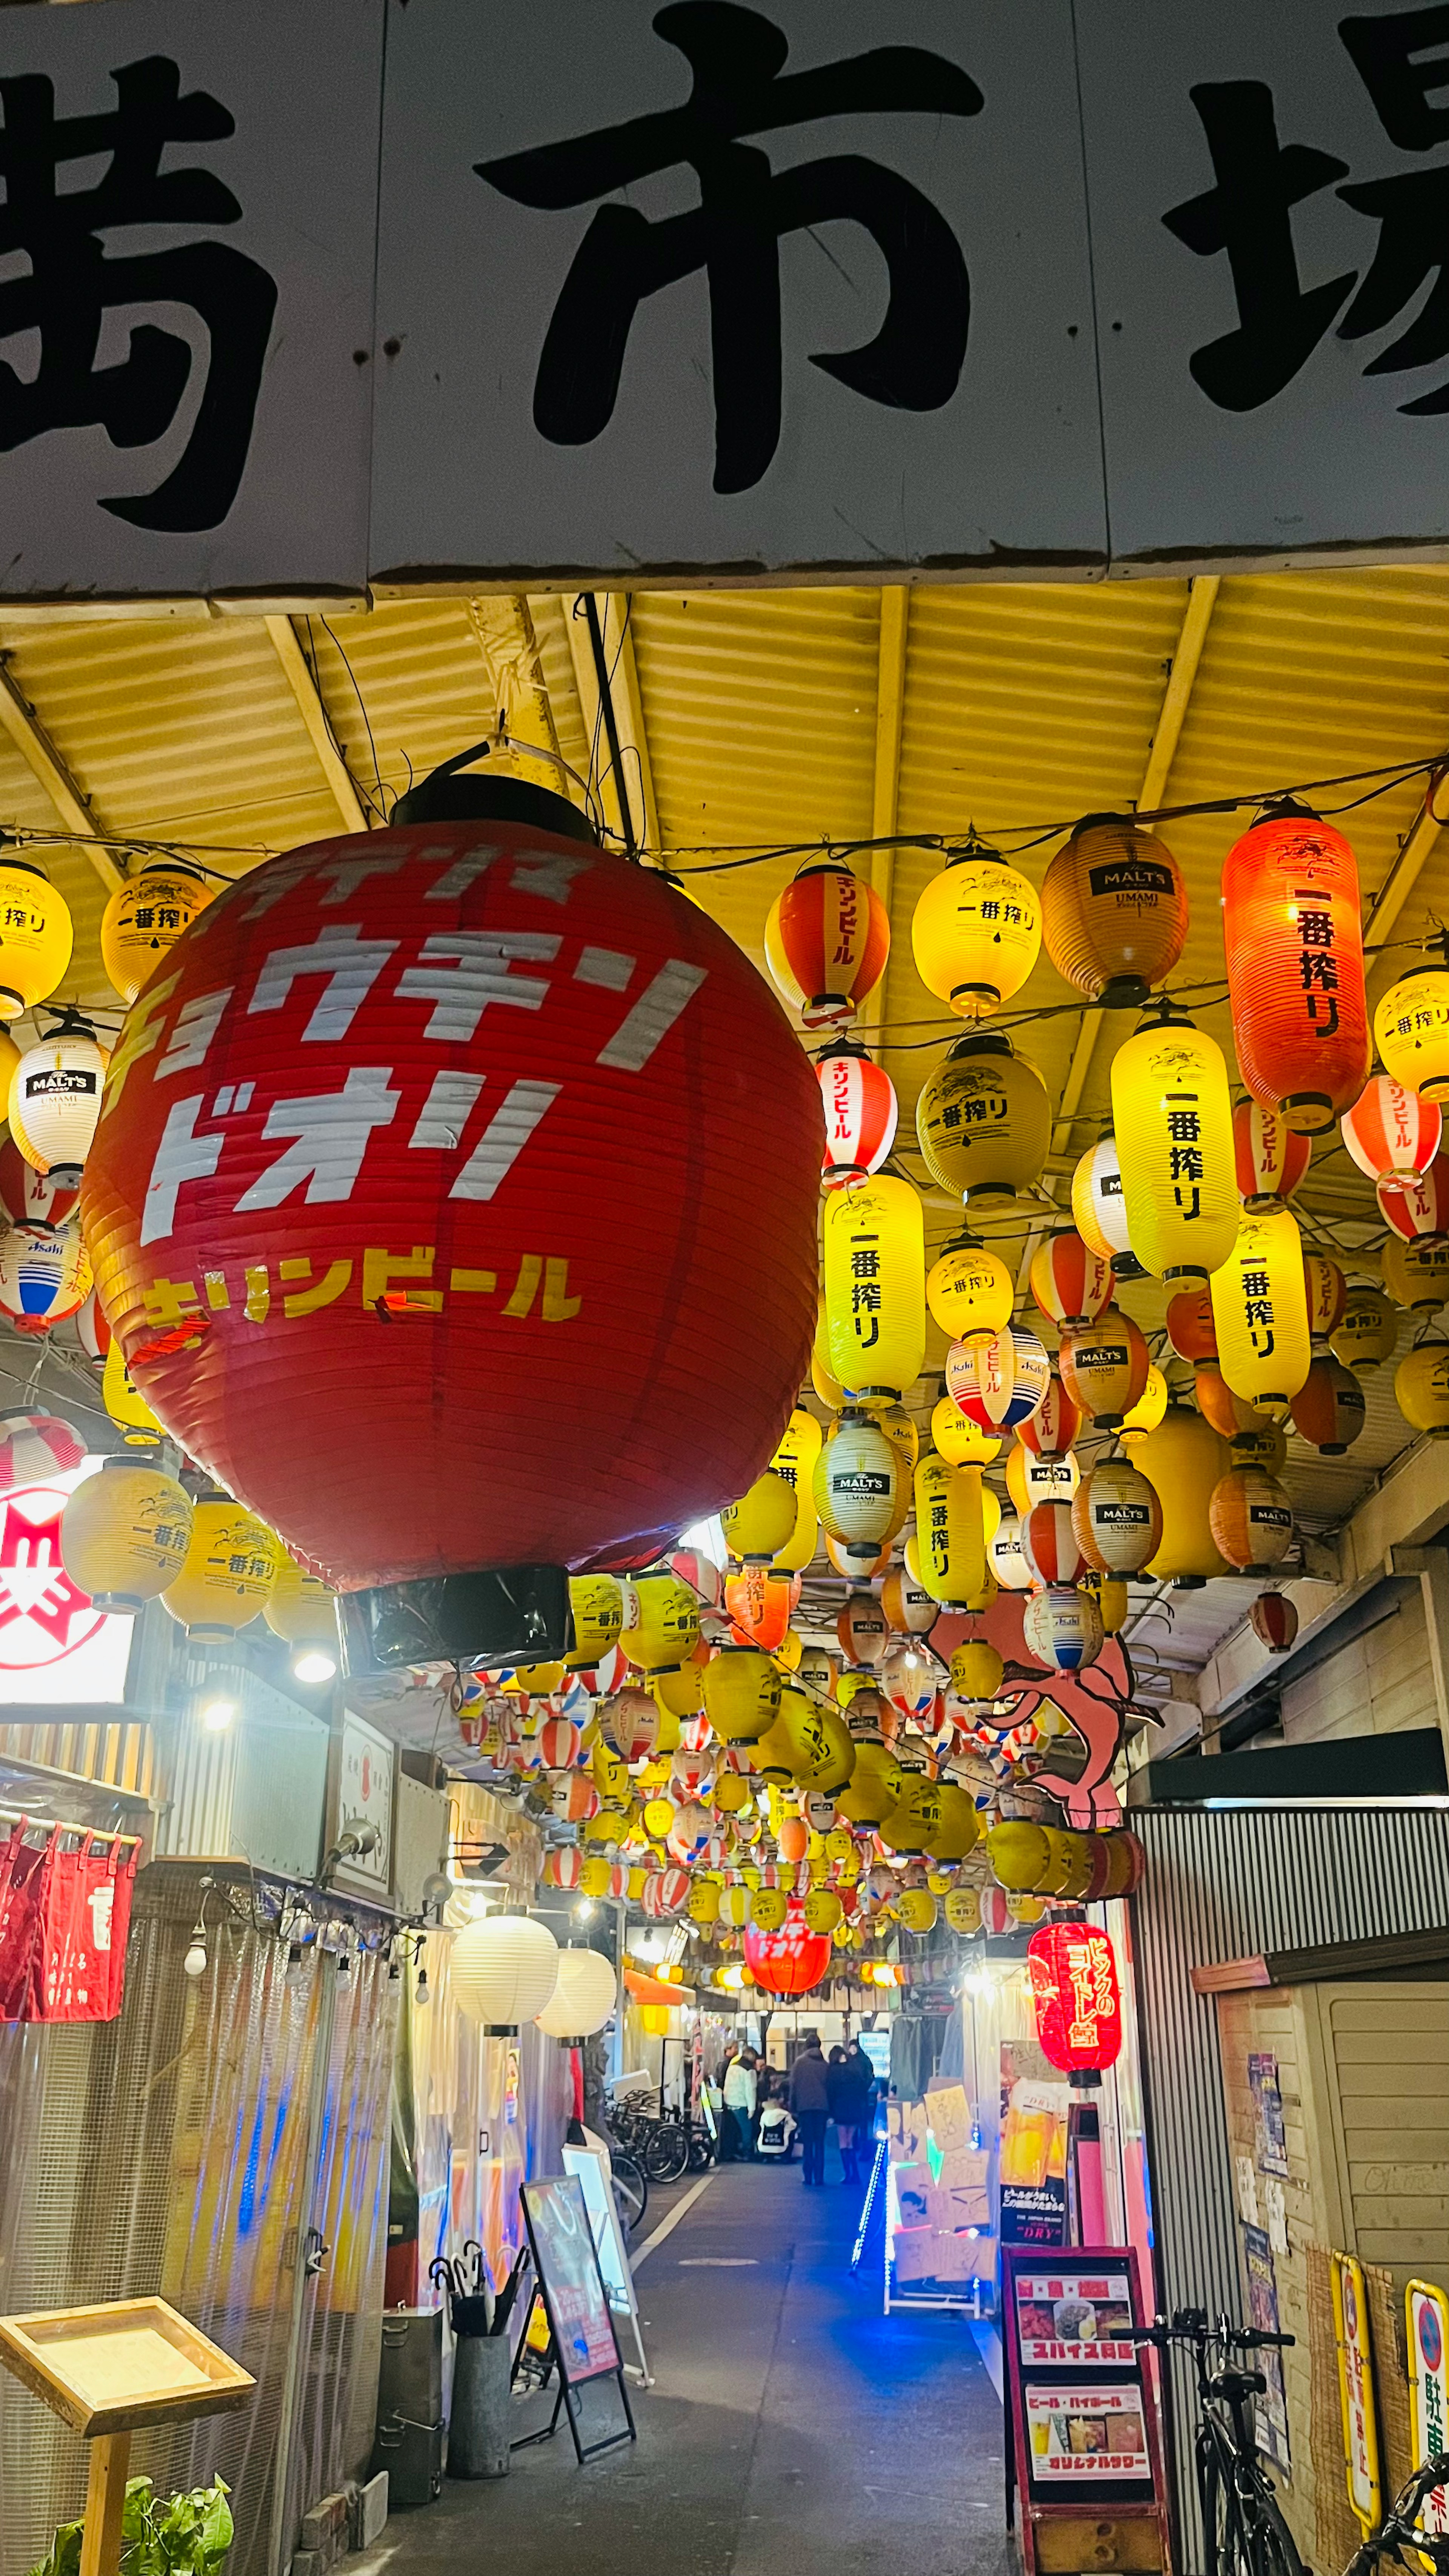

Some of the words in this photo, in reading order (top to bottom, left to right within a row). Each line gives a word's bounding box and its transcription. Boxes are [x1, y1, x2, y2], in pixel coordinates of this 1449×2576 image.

[1116, 893, 1158, 902] UMAMI
[0, 908, 45, 932] 搾り
[832, 877, 856, 965] キリンビール
[958, 901, 1035, 931] 一番搾り
[1294, 889, 1338, 1038] 一番搾り
[33, 1076, 87, 1091] MALT'S
[42, 1095, 77, 1104] UMAMI
[833, 1062, 852, 1139] キリンビール
[928, 1099, 1008, 1129] 一番搾り
[140, 1066, 565, 1247] ドオリ
[1166, 1093, 1203, 1221] 一番搾り
[28, 1241, 63, 1255] Asahi
[850, 1235, 881, 1349] 一番搾り
[941, 1276, 995, 1295] 一番搾り
[1241, 1257, 1274, 1358] 一番搾り
[1338, 1316, 1382, 1329] 一番搾り
[1082, 1350, 1121, 1363] MALT'S
[840, 1478, 883, 1489] MALT'S
[1104, 1509, 1143, 1519] MALT'S
[929, 1495, 949, 1576] 一番搾り
